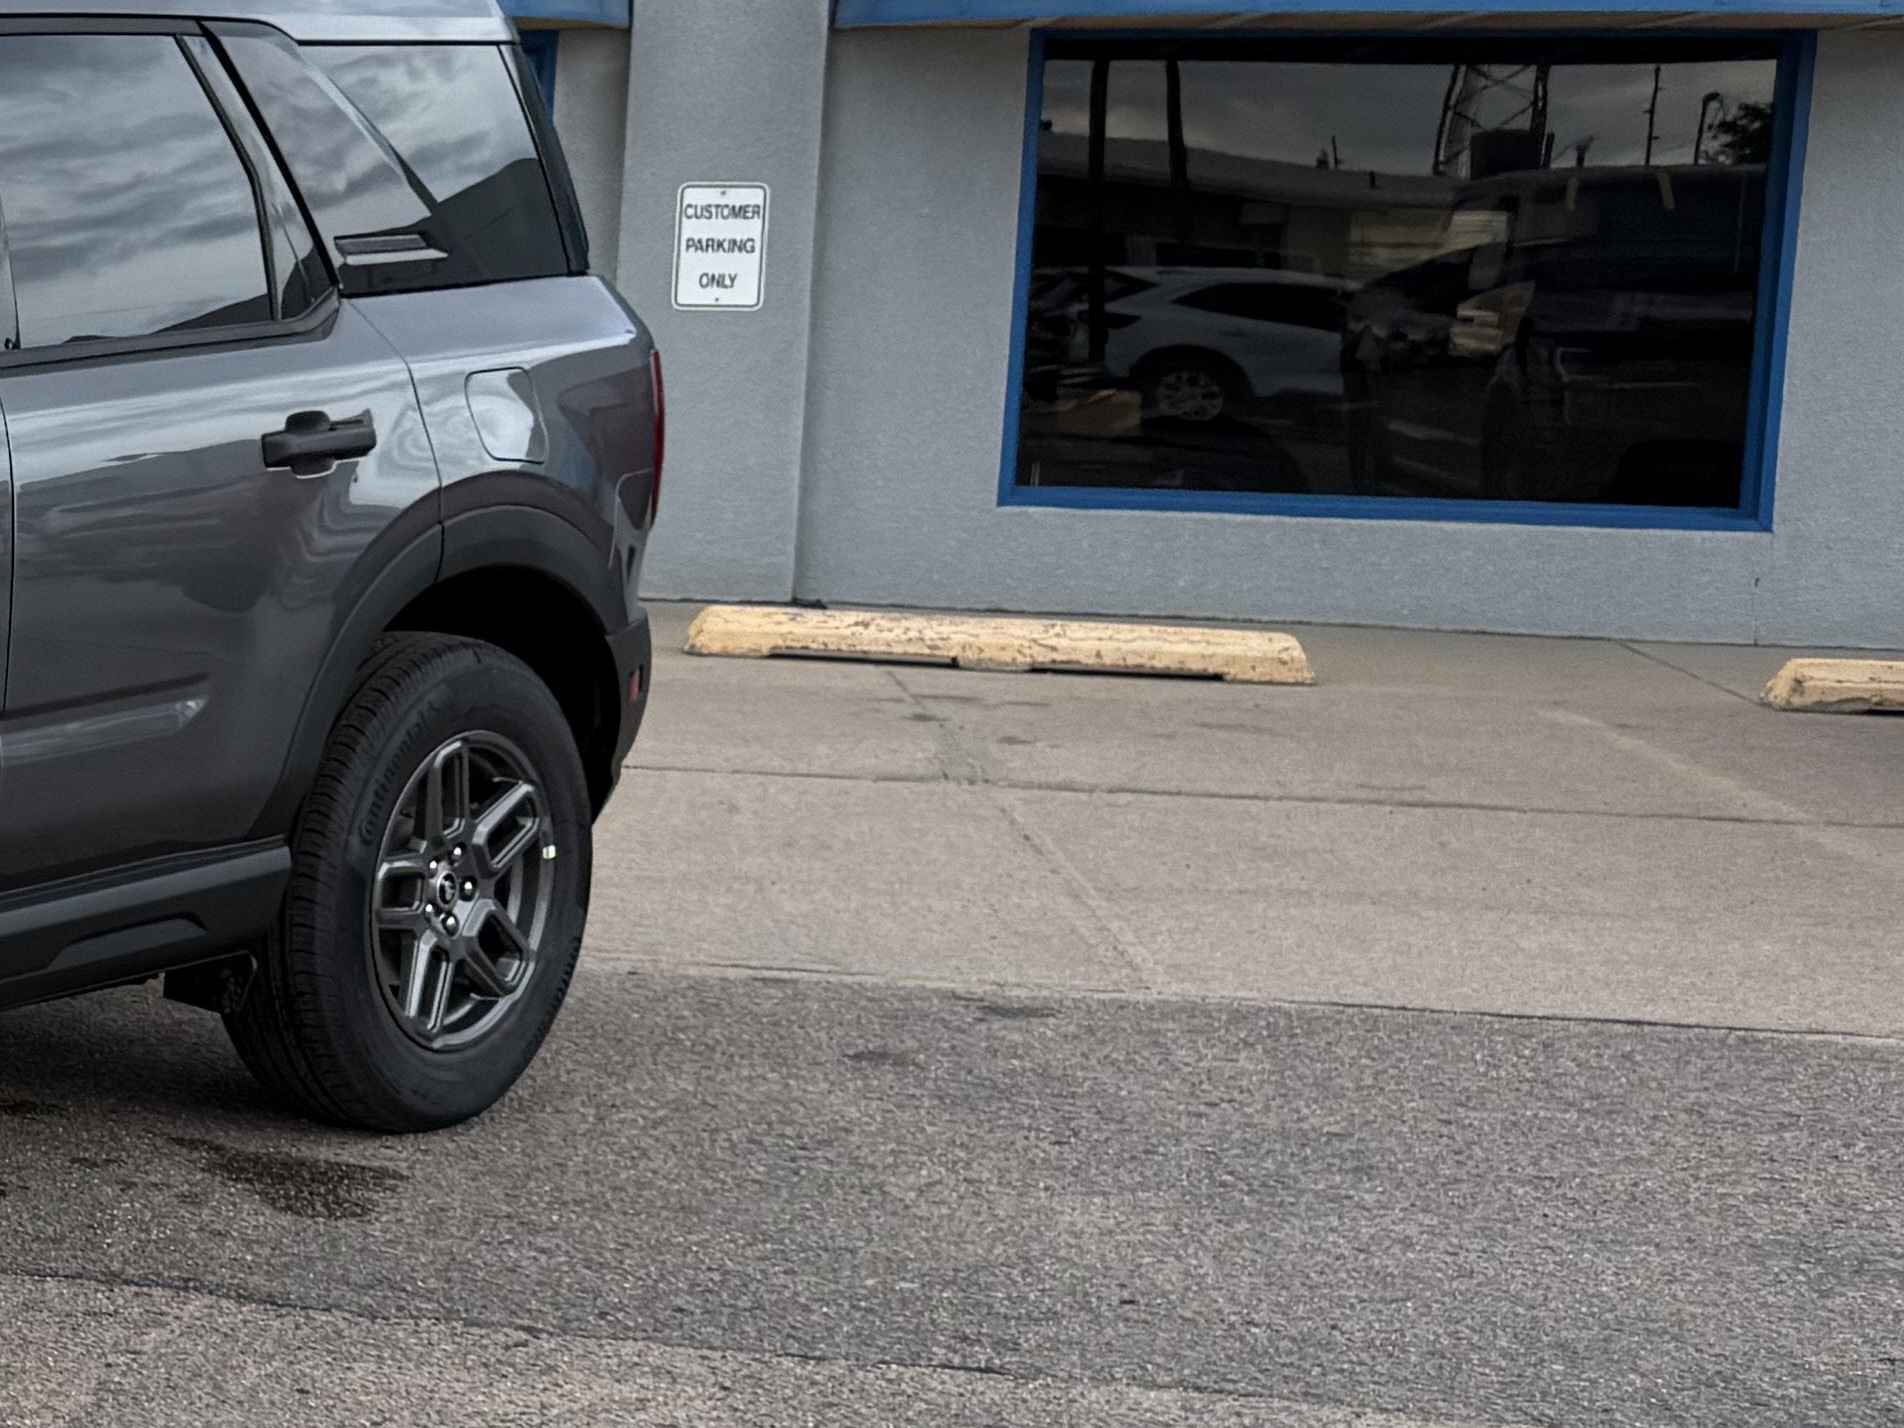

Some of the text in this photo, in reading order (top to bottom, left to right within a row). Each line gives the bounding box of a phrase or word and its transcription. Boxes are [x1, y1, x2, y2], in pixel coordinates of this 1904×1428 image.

[683, 203, 762, 221] CUSTOMER
[685, 237, 757, 254] PARKING
[698, 272, 738, 289] ONLY
